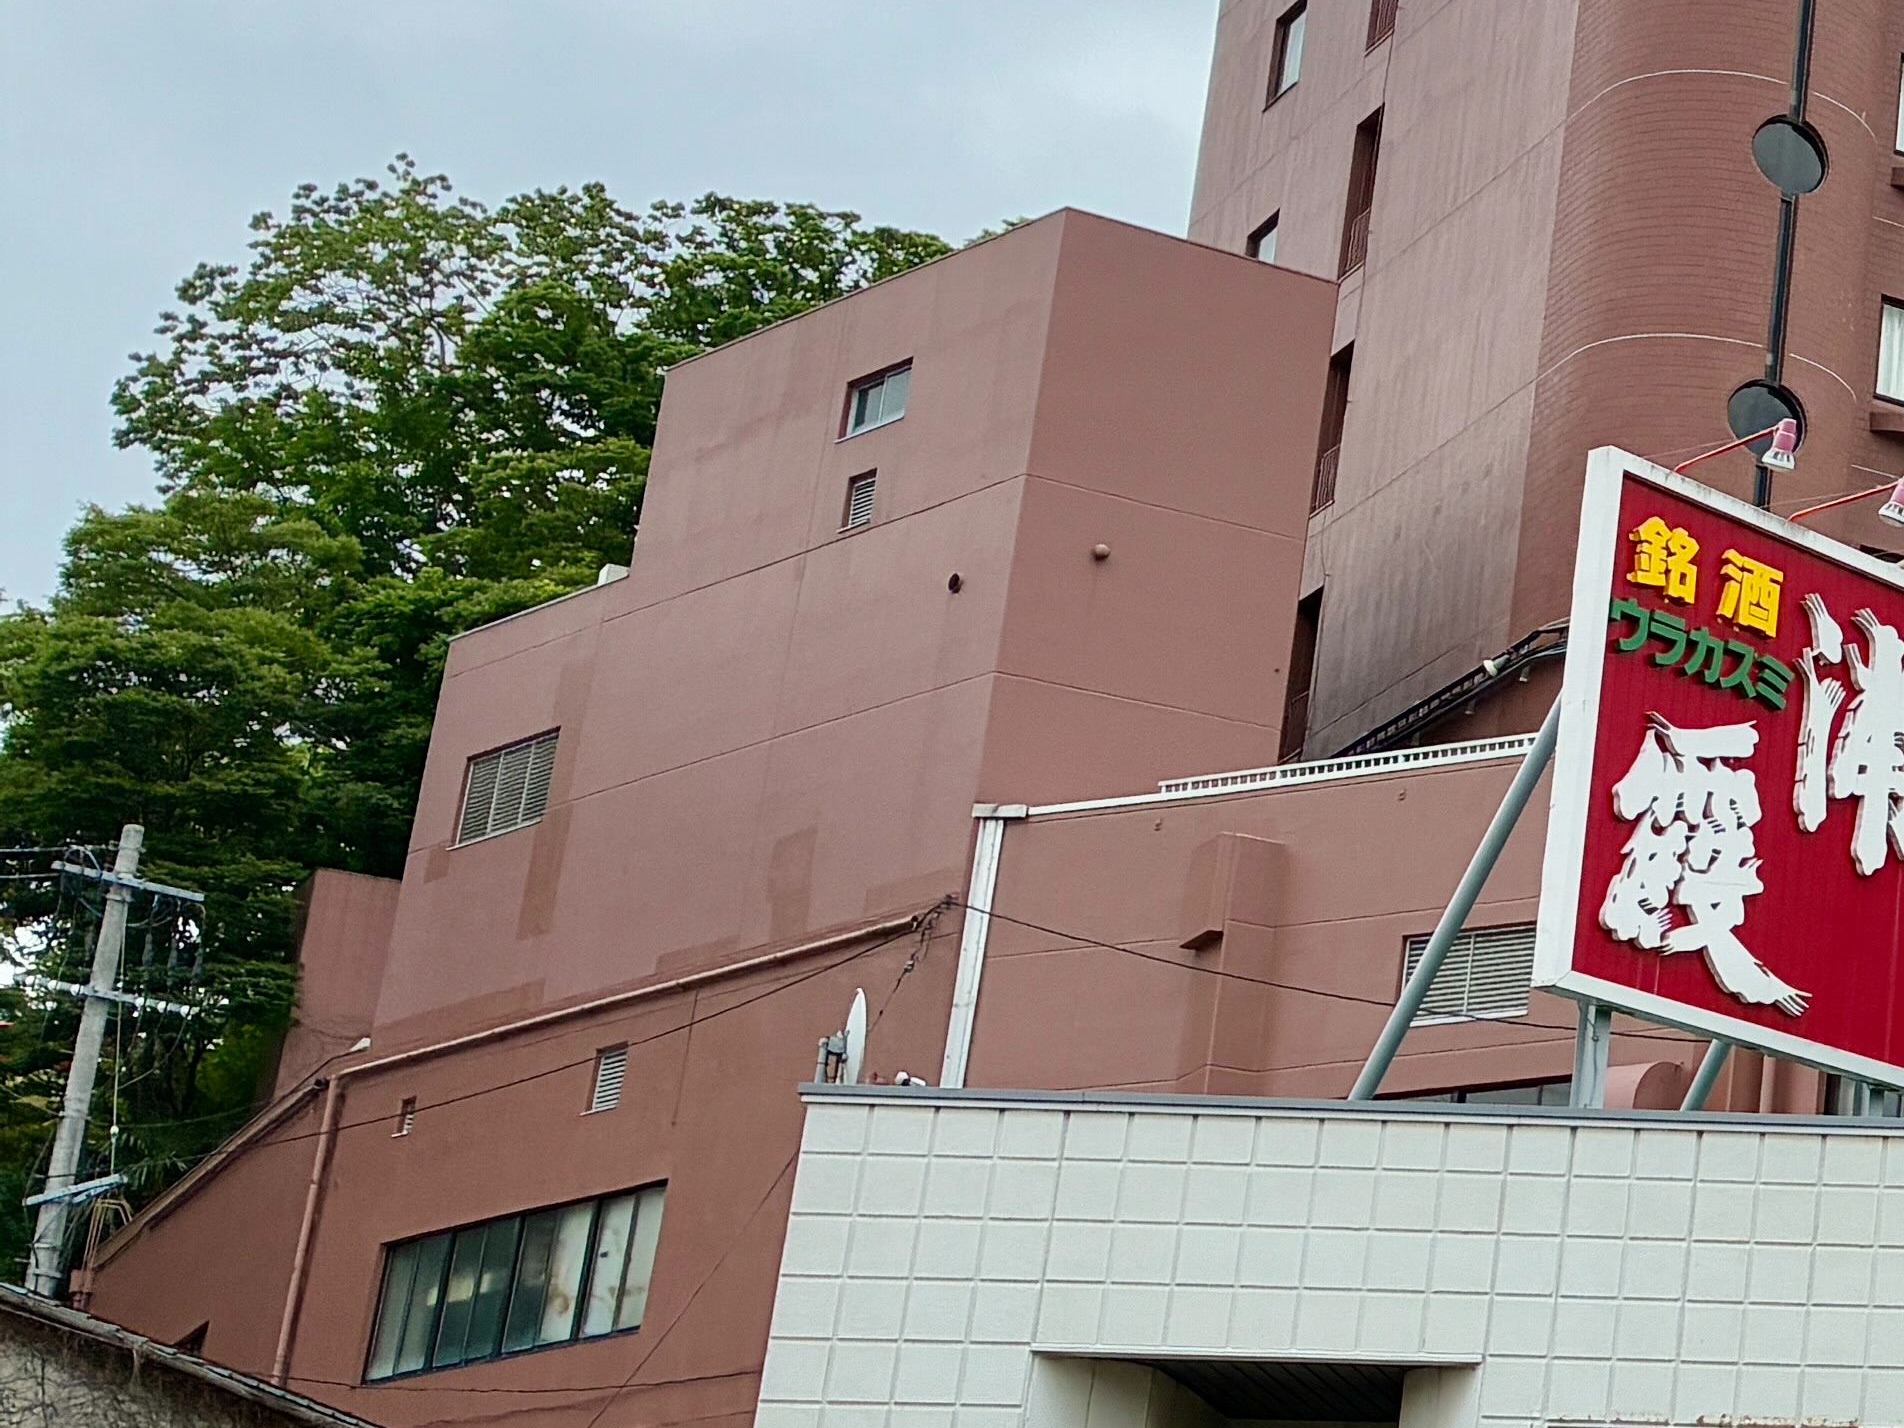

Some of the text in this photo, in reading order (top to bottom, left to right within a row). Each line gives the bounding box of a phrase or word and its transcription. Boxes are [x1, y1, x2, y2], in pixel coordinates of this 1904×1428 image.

[1628, 515, 1785, 639] 銘酒
[1609, 597, 1796, 710] ウラカスミ
